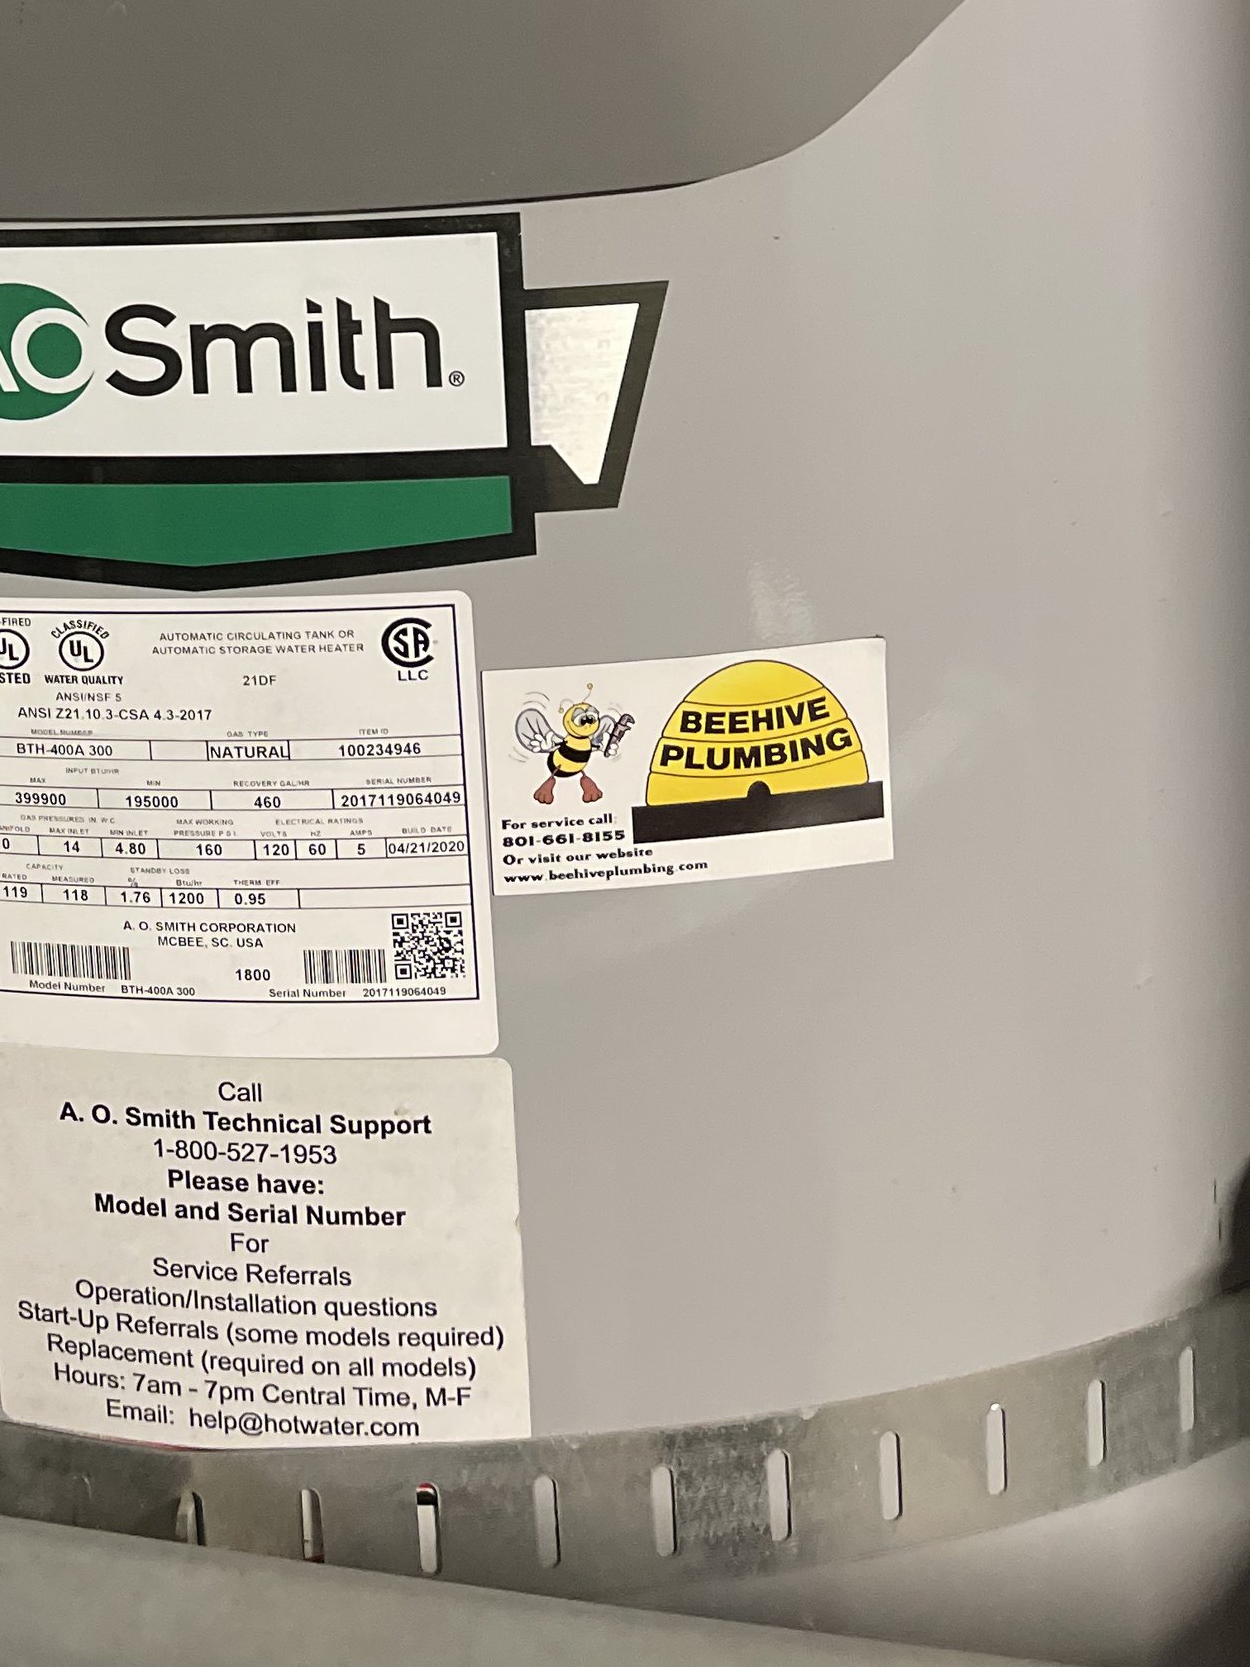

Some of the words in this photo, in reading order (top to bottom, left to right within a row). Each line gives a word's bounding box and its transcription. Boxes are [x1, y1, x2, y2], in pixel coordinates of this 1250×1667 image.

[51, 619, 110, 639] CLASSIFIED
[159, 633, 223, 641] AUTOMATIC
[227, 631, 301, 641] CIRCULATING
[307, 631, 334, 639] TANK
[339, 630, 354, 638] OR
[69, 640, 94, 663] UL
[152, 646, 215, 654] AUTOMATIC
[219, 645, 272, 654] STORAGE
[276, 644, 316, 653] WATER
[319, 643, 364, 652] HEATER
[44, 675, 78, 684] WATER
[82, 675, 123, 685] QUALITY
[243, 675, 277, 686] 21DF
[398, 670, 428, 681] LLC
[56, 692, 112, 701] ANSI/NSF
[115, 693, 122, 701] 5
[18, 707, 50, 718] ANSI
[56, 708, 149, 720] Z21.10.3-CSA
[153, 709, 212, 721] 4.3-2017
[680, 696, 830, 734] BEEHIVE
[17, 743, 84, 755] BTH-400A
[89, 745, 112, 756] 300
[210, 745, 289, 759] NATURAL
[339, 743, 421, 757] 100234946
[660, 728, 852, 770] PLUMBING
[15, 792, 66, 805] 399900
[125, 796, 178, 808] 195000
[254, 796, 281, 808] 460
[341, 791, 461, 807] 2017119064049
[501, 819, 528, 830] For
[532, 817, 584, 829] service
[2, 838, 9, 849] 0
[503, 829, 624, 848] 801-661-8155
[63, 841, 79, 852] 14
[115, 842, 145, 854] 4.80
[196, 844, 222, 855] 160
[263, 844, 289, 856] 120
[309, 843, 326, 855] 60
[358, 843, 365, 855] 5
[388, 840, 464, 854] 04/21/2020
[503, 854, 523, 865] Or
[529, 852, 560, 864] visit
[565, 850, 591, 863] our
[596, 847, 653, 861] website
[505, 859, 708, 884] www.beehiveplumbing.com
[3, 886, 27, 898] 119
[63, 889, 88, 901] 118
[121, 891, 151, 903] 1.76
[169, 893, 204, 904] 1200
[234, 893, 265, 905] 0.95
[123, 921, 135, 930] A.
[139, 921, 151, 931] O.
[156, 922, 195, 932] SMITH
[200, 922, 296, 933] CORPORATION
[158, 936, 208, 948] MCBEE,
[237, 938, 263, 948] USA
[235, 969, 270, 980] 1800
[29, 980, 60, 990] Model
[64, 982, 105, 992] Number
[121, 985, 173, 995] BTH-400A
[177, 987, 195, 996] 300
[269, 989, 299, 998] Serial
[303, 989, 346, 997] Number
[363, 987, 446, 997] 2017119064049
[218, 1082, 262, 1102] Call
[60, 1104, 84, 1122] A.
[92, 1105, 117, 1125] O.
[125, 1108, 195, 1129] Smith
[203, 1111, 321, 1134] Technical
[329, 1114, 431, 1139] Support
[153, 1139, 337, 1165] 1-800-527-1953
[167, 1170, 249, 1193] Please
[257, 1172, 324, 1194] have:
[95, 1194, 166, 1218] Model
[174, 1199, 219, 1221] and
[227, 1202, 298, 1224] Serial
[306, 1205, 405, 1227] Number
[230, 1233, 268, 1252] For
[153, 1257, 238, 1282] Service
[246, 1263, 351, 1286] Referrals
[75, 1280, 316, 1316] Operation/Installation
[324, 1295, 437, 1319] questions
[18, 1301, 109, 1333] Start-Up
[116, 1316, 218, 1340] Referrals
[227, 1322, 297, 1346] (some
[305, 1327, 389, 1347] models
[398, 1326, 504, 1350] required)
[47, 1334, 194, 1368] Replacement
[201, 1349, 304, 1376] (required
[312, 1359, 340, 1375] on
[348, 1355, 374, 1376] all
[382, 1357, 476, 1379] models)
[53, 1362, 125, 1390] Hours:
[132, 1373, 182, 1397] 7am
[204, 1378, 254, 1403] 7pm
[262, 1384, 345, 1406] Central
[353, 1387, 417, 1410] Time,
[425, 1388, 472, 1407] M-F
[106, 1399, 175, 1426] Email:
[189, 1409, 419, 1437] help@hotwater.com
